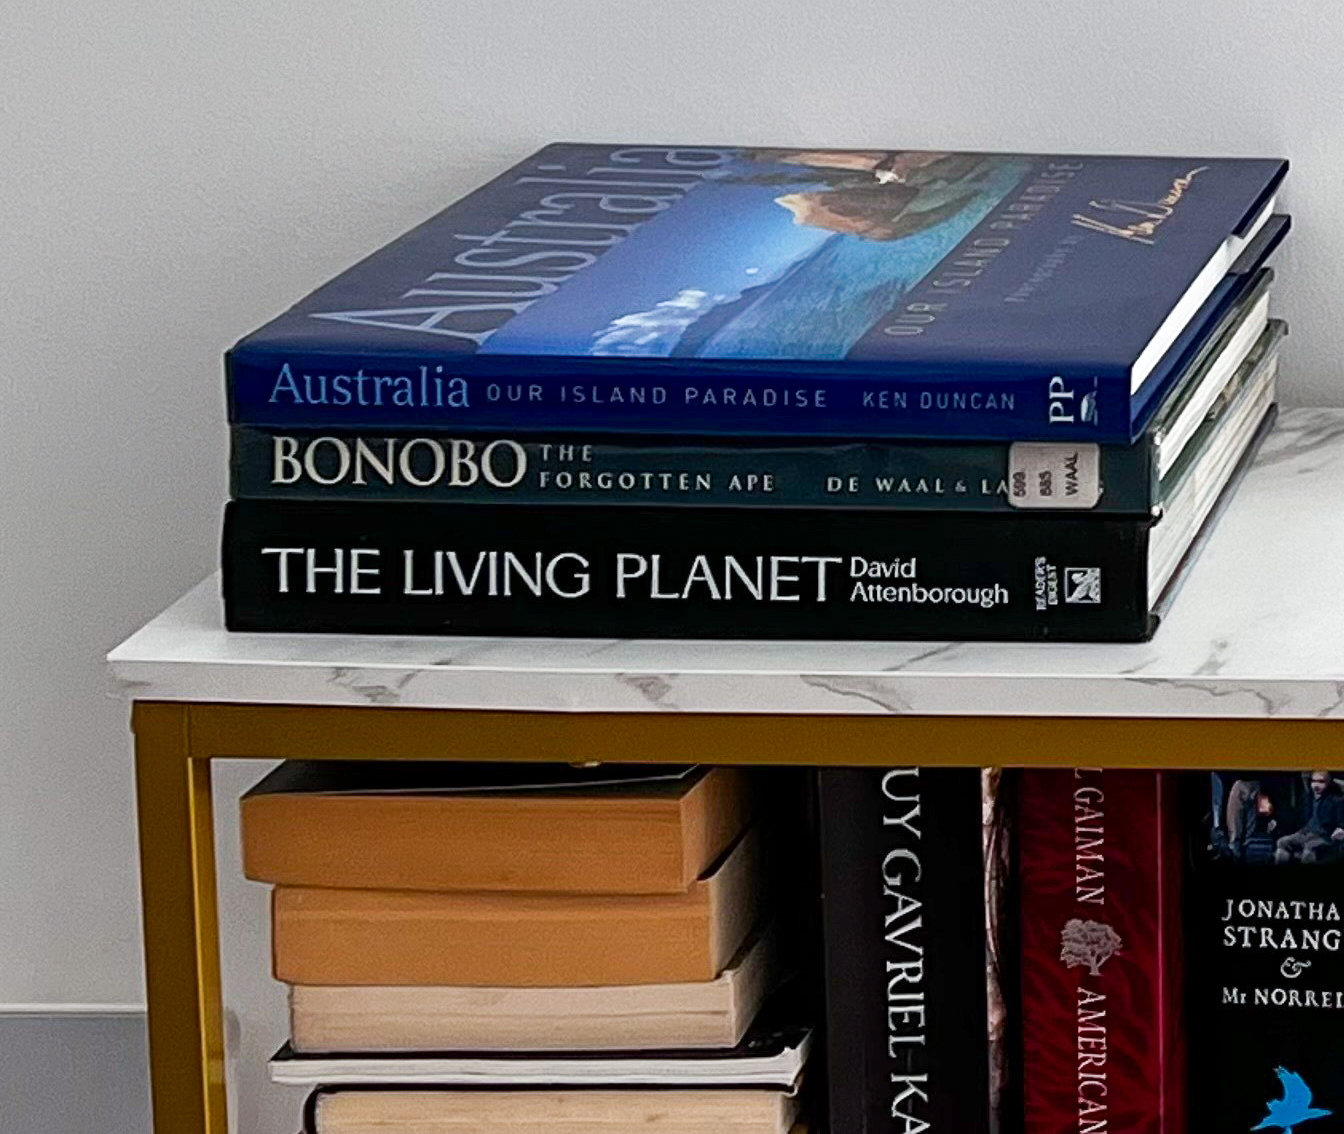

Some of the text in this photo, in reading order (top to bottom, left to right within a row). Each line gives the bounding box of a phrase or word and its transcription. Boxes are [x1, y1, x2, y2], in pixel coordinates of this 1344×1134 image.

[308, 147, 735, 343] Australia
[884, 302, 951, 336] OUR
[926, 238, 1010, 295] ISLAND
[989, 162, 1084, 231] PARADISE
[268, 362, 1016, 411] Australia OUR ISLAND PARADISE KEN DUNCAN
[1049, 375, 1074, 424] PP
[270, 435, 527, 488] BONOBO
[540, 444, 593, 463] THE
[1065, 451, 1079, 497] WAAL
[539, 470, 775, 493] FORGOTTEN APE
[826, 476, 859, 493] DE
[875, 477, 945, 494] WAAL
[1012, 471, 1027, 498] 599
[262, 547, 842, 602] THE LIVING PLANET
[849, 555, 917, 579] David
[849, 580, 1009, 608] Attenborough
[1073, 786, 1105, 906] GAIMAN
[880, 847, 927, 1059] GAVRIEL
[1280, 956, 1312, 979] &
[1221, 986, 1247, 1004] Mr
[1076, 985, 1108, 1134] AMERICAN
